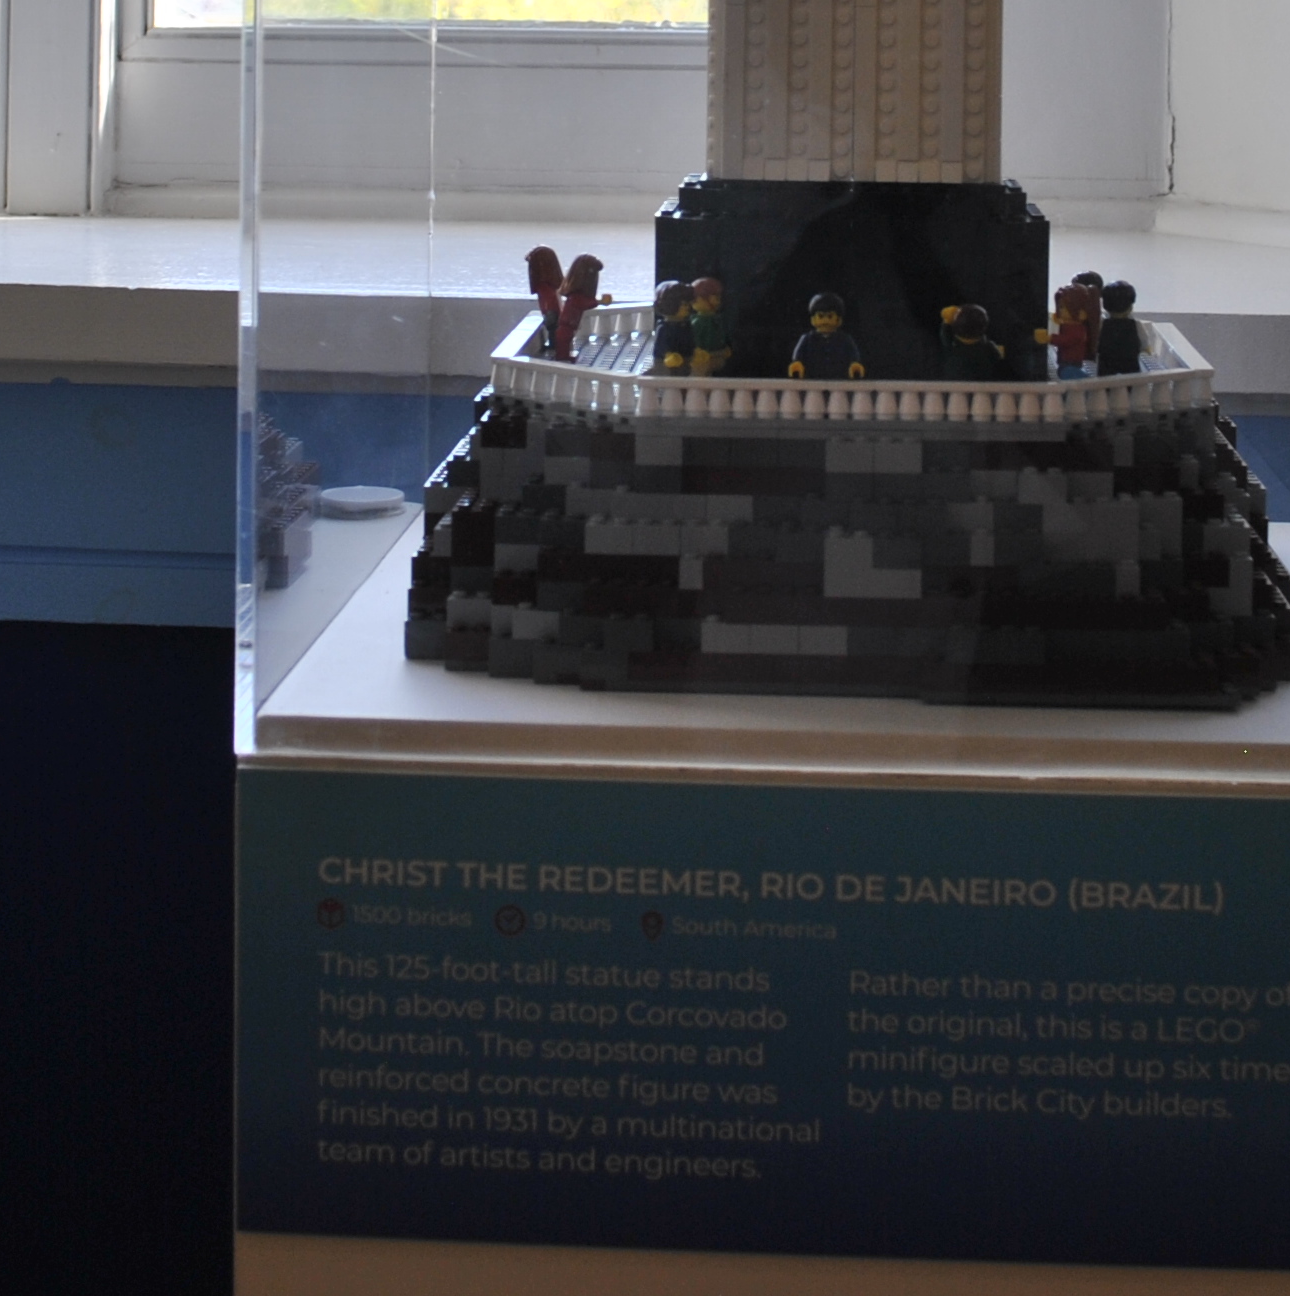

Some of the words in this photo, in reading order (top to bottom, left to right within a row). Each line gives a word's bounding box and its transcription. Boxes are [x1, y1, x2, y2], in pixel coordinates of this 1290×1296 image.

[318, 857, 449, 888] CHRIST
[457, 862, 528, 891] THE
[538, 865, 749, 902] REDEEMER,
[761, 872, 824, 901] RIO
[835, 874, 885, 902] DE
[894, 877, 1056, 905] JANEIRO
[1069, 881, 1225, 914] (BRAZIL)
[352, 905, 401, 926] 1500
[407, 908, 472, 928] bricks
[532, 913, 547, 931] 9
[551, 913, 611, 932] hours
[671, 917, 736, 937] South
[742, 920, 837, 940] America
[318, 951, 378, 977] This
[386, 954, 557, 985] 125-foot-tall
[565, 962, 660, 989] statue
[668, 966, 770, 992] stands
[318, 990, 385, 1021] high
[394, 994, 487, 1020] above
[494, 996, 541, 1022] Rio
[550, 1000, 619, 1029] atop
[626, 1002, 788, 1030] Corcovado
[849, 970, 953, 999] Rather
[960, 974, 1032, 1001] than
[1040, 981, 1058, 1002] a
[1066, 980, 1176, 1011] precise
[1183, 984, 1259, 1013] copy
[847, 1009, 899, 1034] the
[907, 1011, 1028, 1044] original,
[1035, 1014, 1092, 1040] this
[1100, 1016, 1123, 1040] is
[1131, 1022, 1148, 1041] a
[318, 1028, 469, 1056] Mountain.
[477, 1032, 534, 1058] The
[540, 1036, 700, 1067] soapstone
[708, 1042, 764, 1067] and
[847, 1048, 1010, 1078] minifigure
[1017, 1052, 1114, 1079] scaled
[1124, 1059, 1165, 1086] up
[1172, 1055, 1211, 1081] six
[318, 1065, 469, 1094] reinforced
[477, 1072, 610, 1098] concrete
[618, 1074, 710, 1107] figure
[718, 1082, 778, 1105] was
[847, 1083, 883, 1114] by
[890, 1086, 942, 1110] the
[951, 1087, 1028, 1114] Brick
[1036, 1089, 1095, 1120] City
[1103, 1091, 1232, 1120] builders.
[317, 1099, 439, 1128] finished
[447, 1105, 473, 1131] in
[483, 1108, 539, 1133] 1931
[547, 1111, 587, 1142] by
[591, 1117, 607, 1136] a
[616, 1113, 820, 1143] multinational
[318, 1141, 395, 1163] team
[403, 1140, 436, 1166] of
[441, 1144, 531, 1170] artists
[538, 1147, 595, 1172] and
[605, 1153, 763, 1181] engineers.
